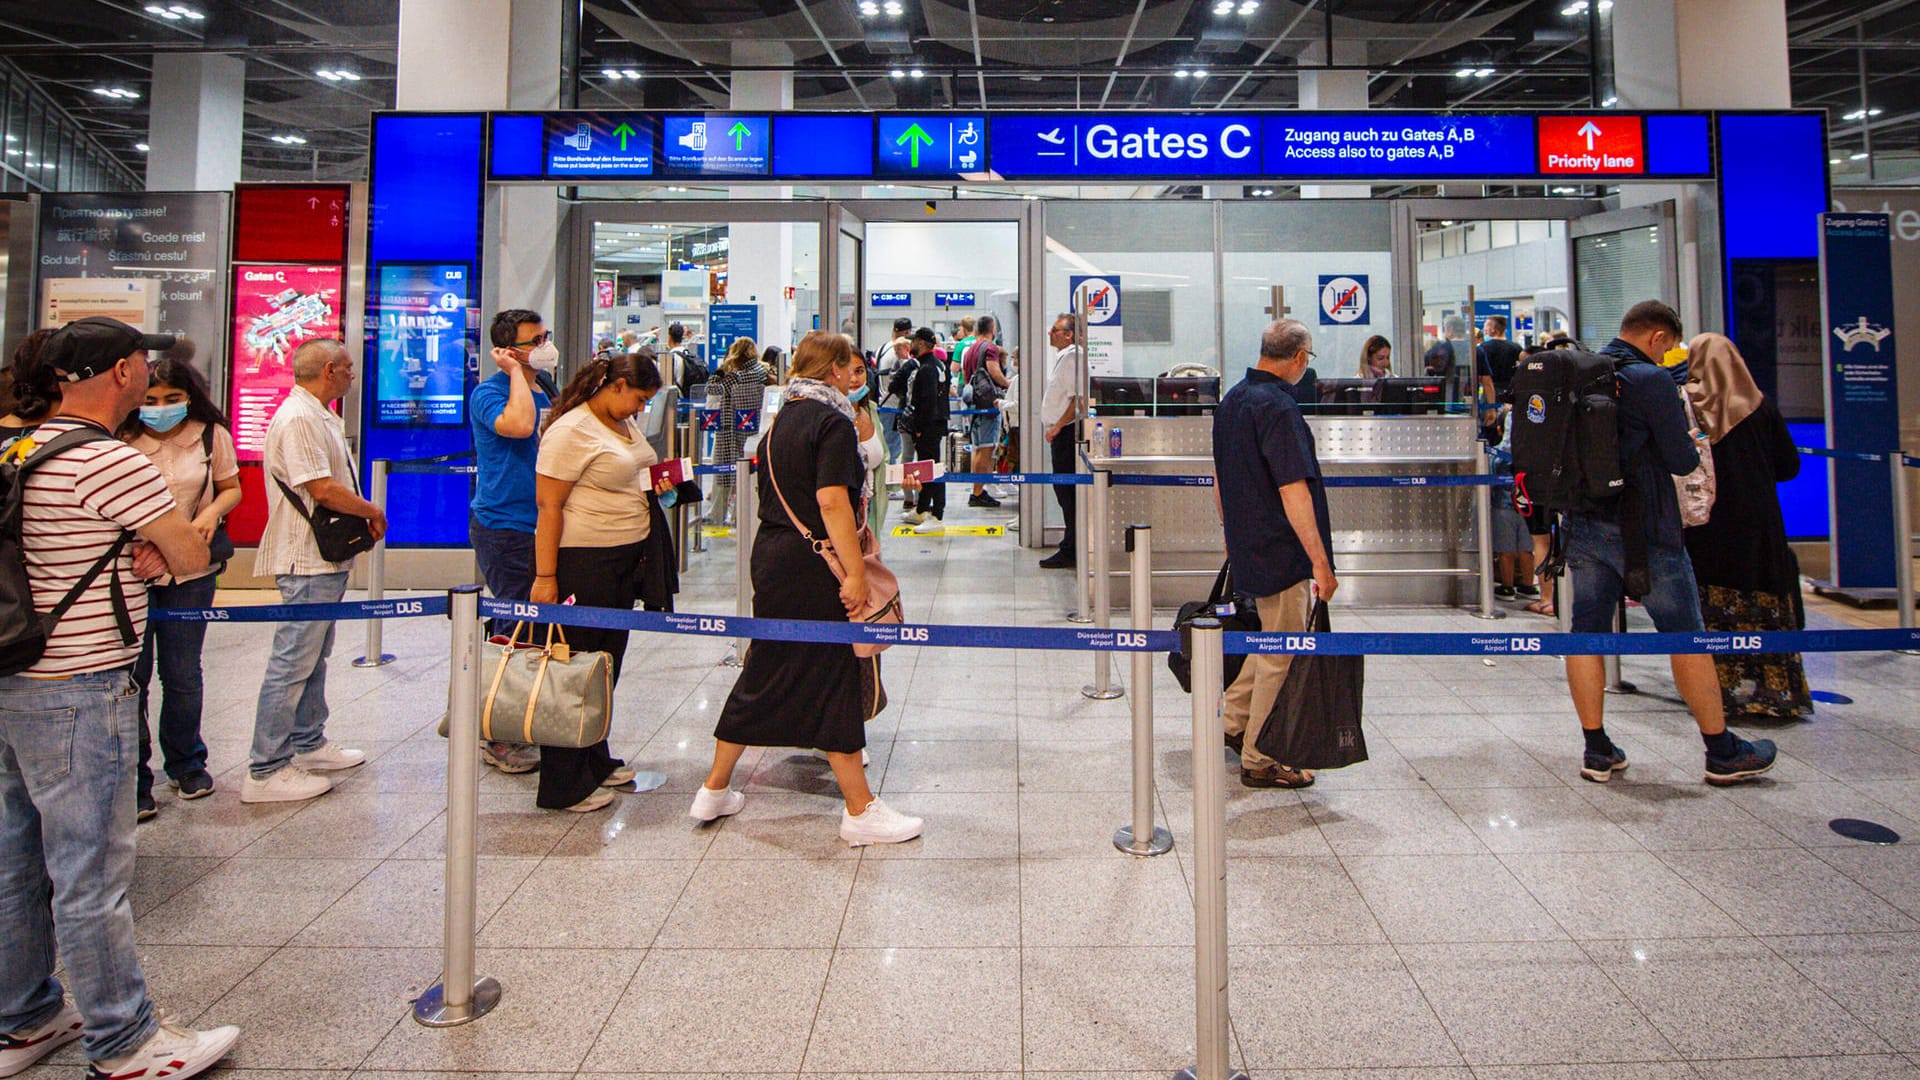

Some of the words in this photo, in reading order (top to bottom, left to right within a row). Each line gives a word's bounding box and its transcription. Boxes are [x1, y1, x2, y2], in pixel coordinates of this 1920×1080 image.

[1086, 124, 1209, 159] Gates
[1220, 124, 1251, 159] C
[1285, 128, 1340, 144] Zugang
[1343, 128, 1378, 141] auch
[1381, 131, 1398, 141] zu
[1402, 128, 1444, 141] Gates
[1447, 128, 1475, 143] A,B
[1285, 145, 1336, 158] Access
[1338, 145, 1366, 158] also
[1369, 145, 1384, 158] to
[1387, 145, 1425, 162] gates
[1428, 145, 1455, 161] A,B
[1548, 154, 1600, 170] Priority
[1604, 154, 1634, 168] lane
[53, 207, 104, 219] Приятно
[105, 206, 167, 220] пътуване!
[1880, 218, 1887, 226] C
[142, 232, 179, 243] Goede
[182, 232, 206, 242] reis!
[41, 255, 62, 265] God
[154, 251, 187, 261] cestu!
[244, 272, 274, 281] Gates
[275, 272, 285, 281] C
[171, 290, 202, 300] olsun!
[1411, 477, 1426, 485] DUS
[397, 601, 423, 614] DUS
[514, 603, 539, 617] DUS
[202, 610, 230, 620] DUS
[700, 618, 726, 632] DUS
[901, 628, 929, 641] DUS
[1117, 633, 1147, 647] DUS
[1286, 637, 1316, 650] DUS
[1511, 638, 1540, 651] DUS
[1733, 636, 1762, 649] DUS
